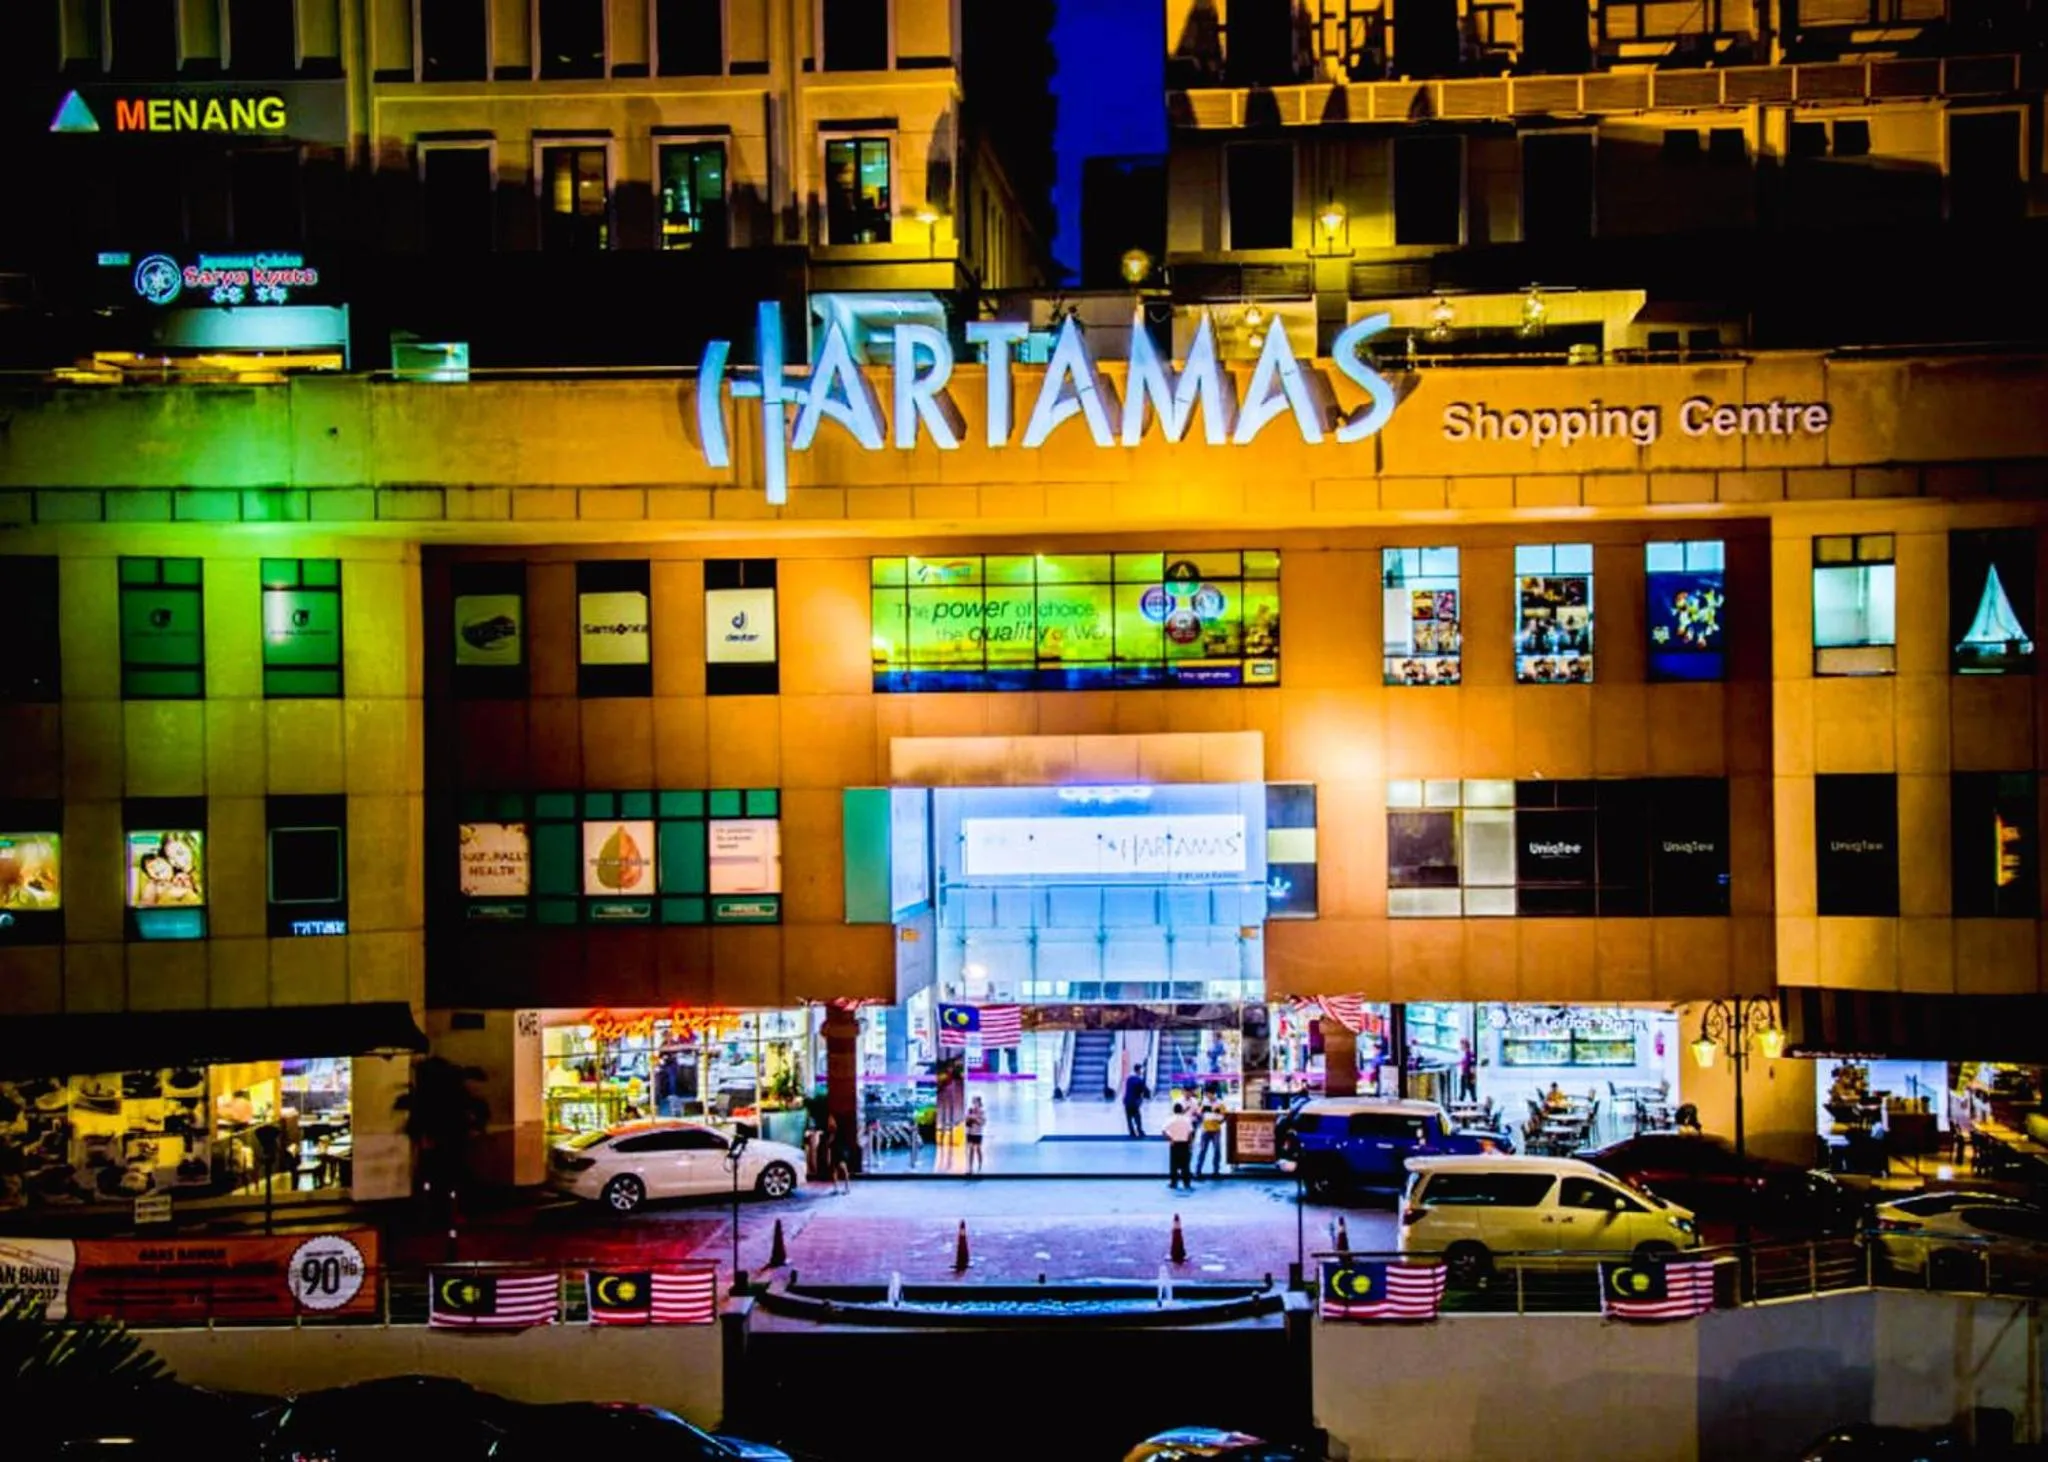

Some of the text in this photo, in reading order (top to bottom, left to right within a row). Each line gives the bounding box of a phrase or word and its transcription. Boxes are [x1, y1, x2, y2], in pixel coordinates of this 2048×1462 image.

[117, 96, 286, 130] MENANG
[700, 301, 1396, 504] HARTAMAS
[1442, 396, 1831, 446] Shopping Centre
[932, 599, 1010, 624] power
[1015, 603, 1030, 618] of
[936, 625, 962, 641] the
[967, 621, 1048, 648] quality
[20, 1266, 60, 1285] BUKU
